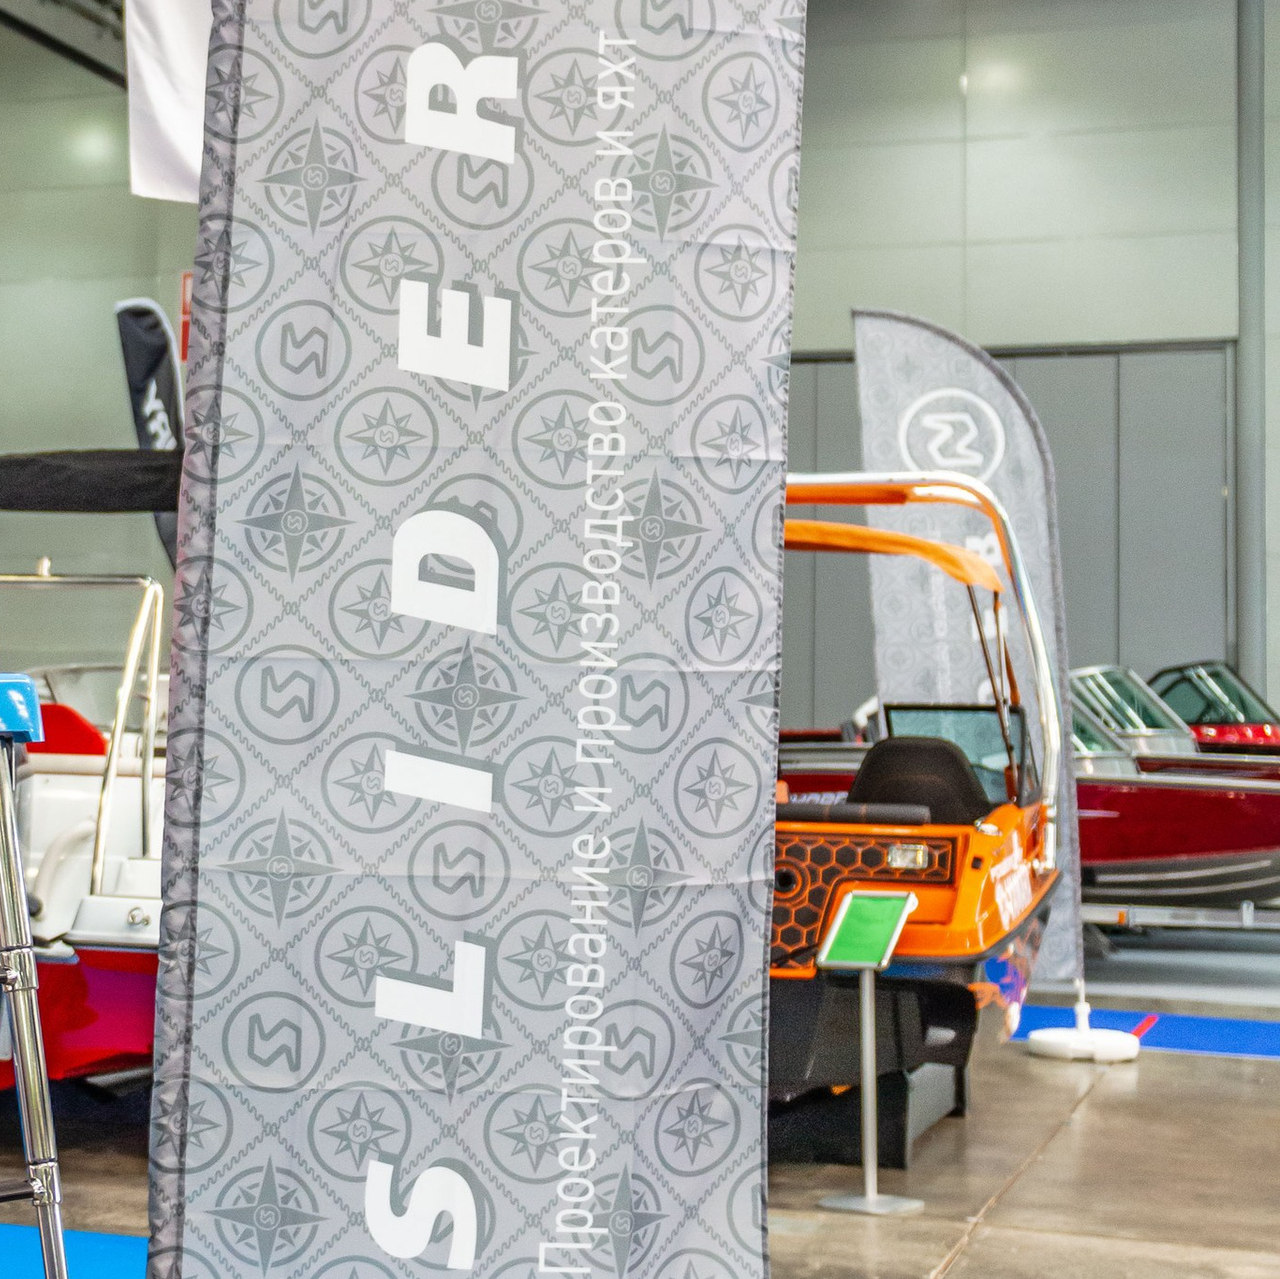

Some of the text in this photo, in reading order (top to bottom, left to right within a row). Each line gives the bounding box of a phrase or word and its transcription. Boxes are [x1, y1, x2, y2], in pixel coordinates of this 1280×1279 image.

[364, 41, 522, 1272] SLIDER
[537, 27, 647, 1275] Проектирование и производство катеров и яхт
